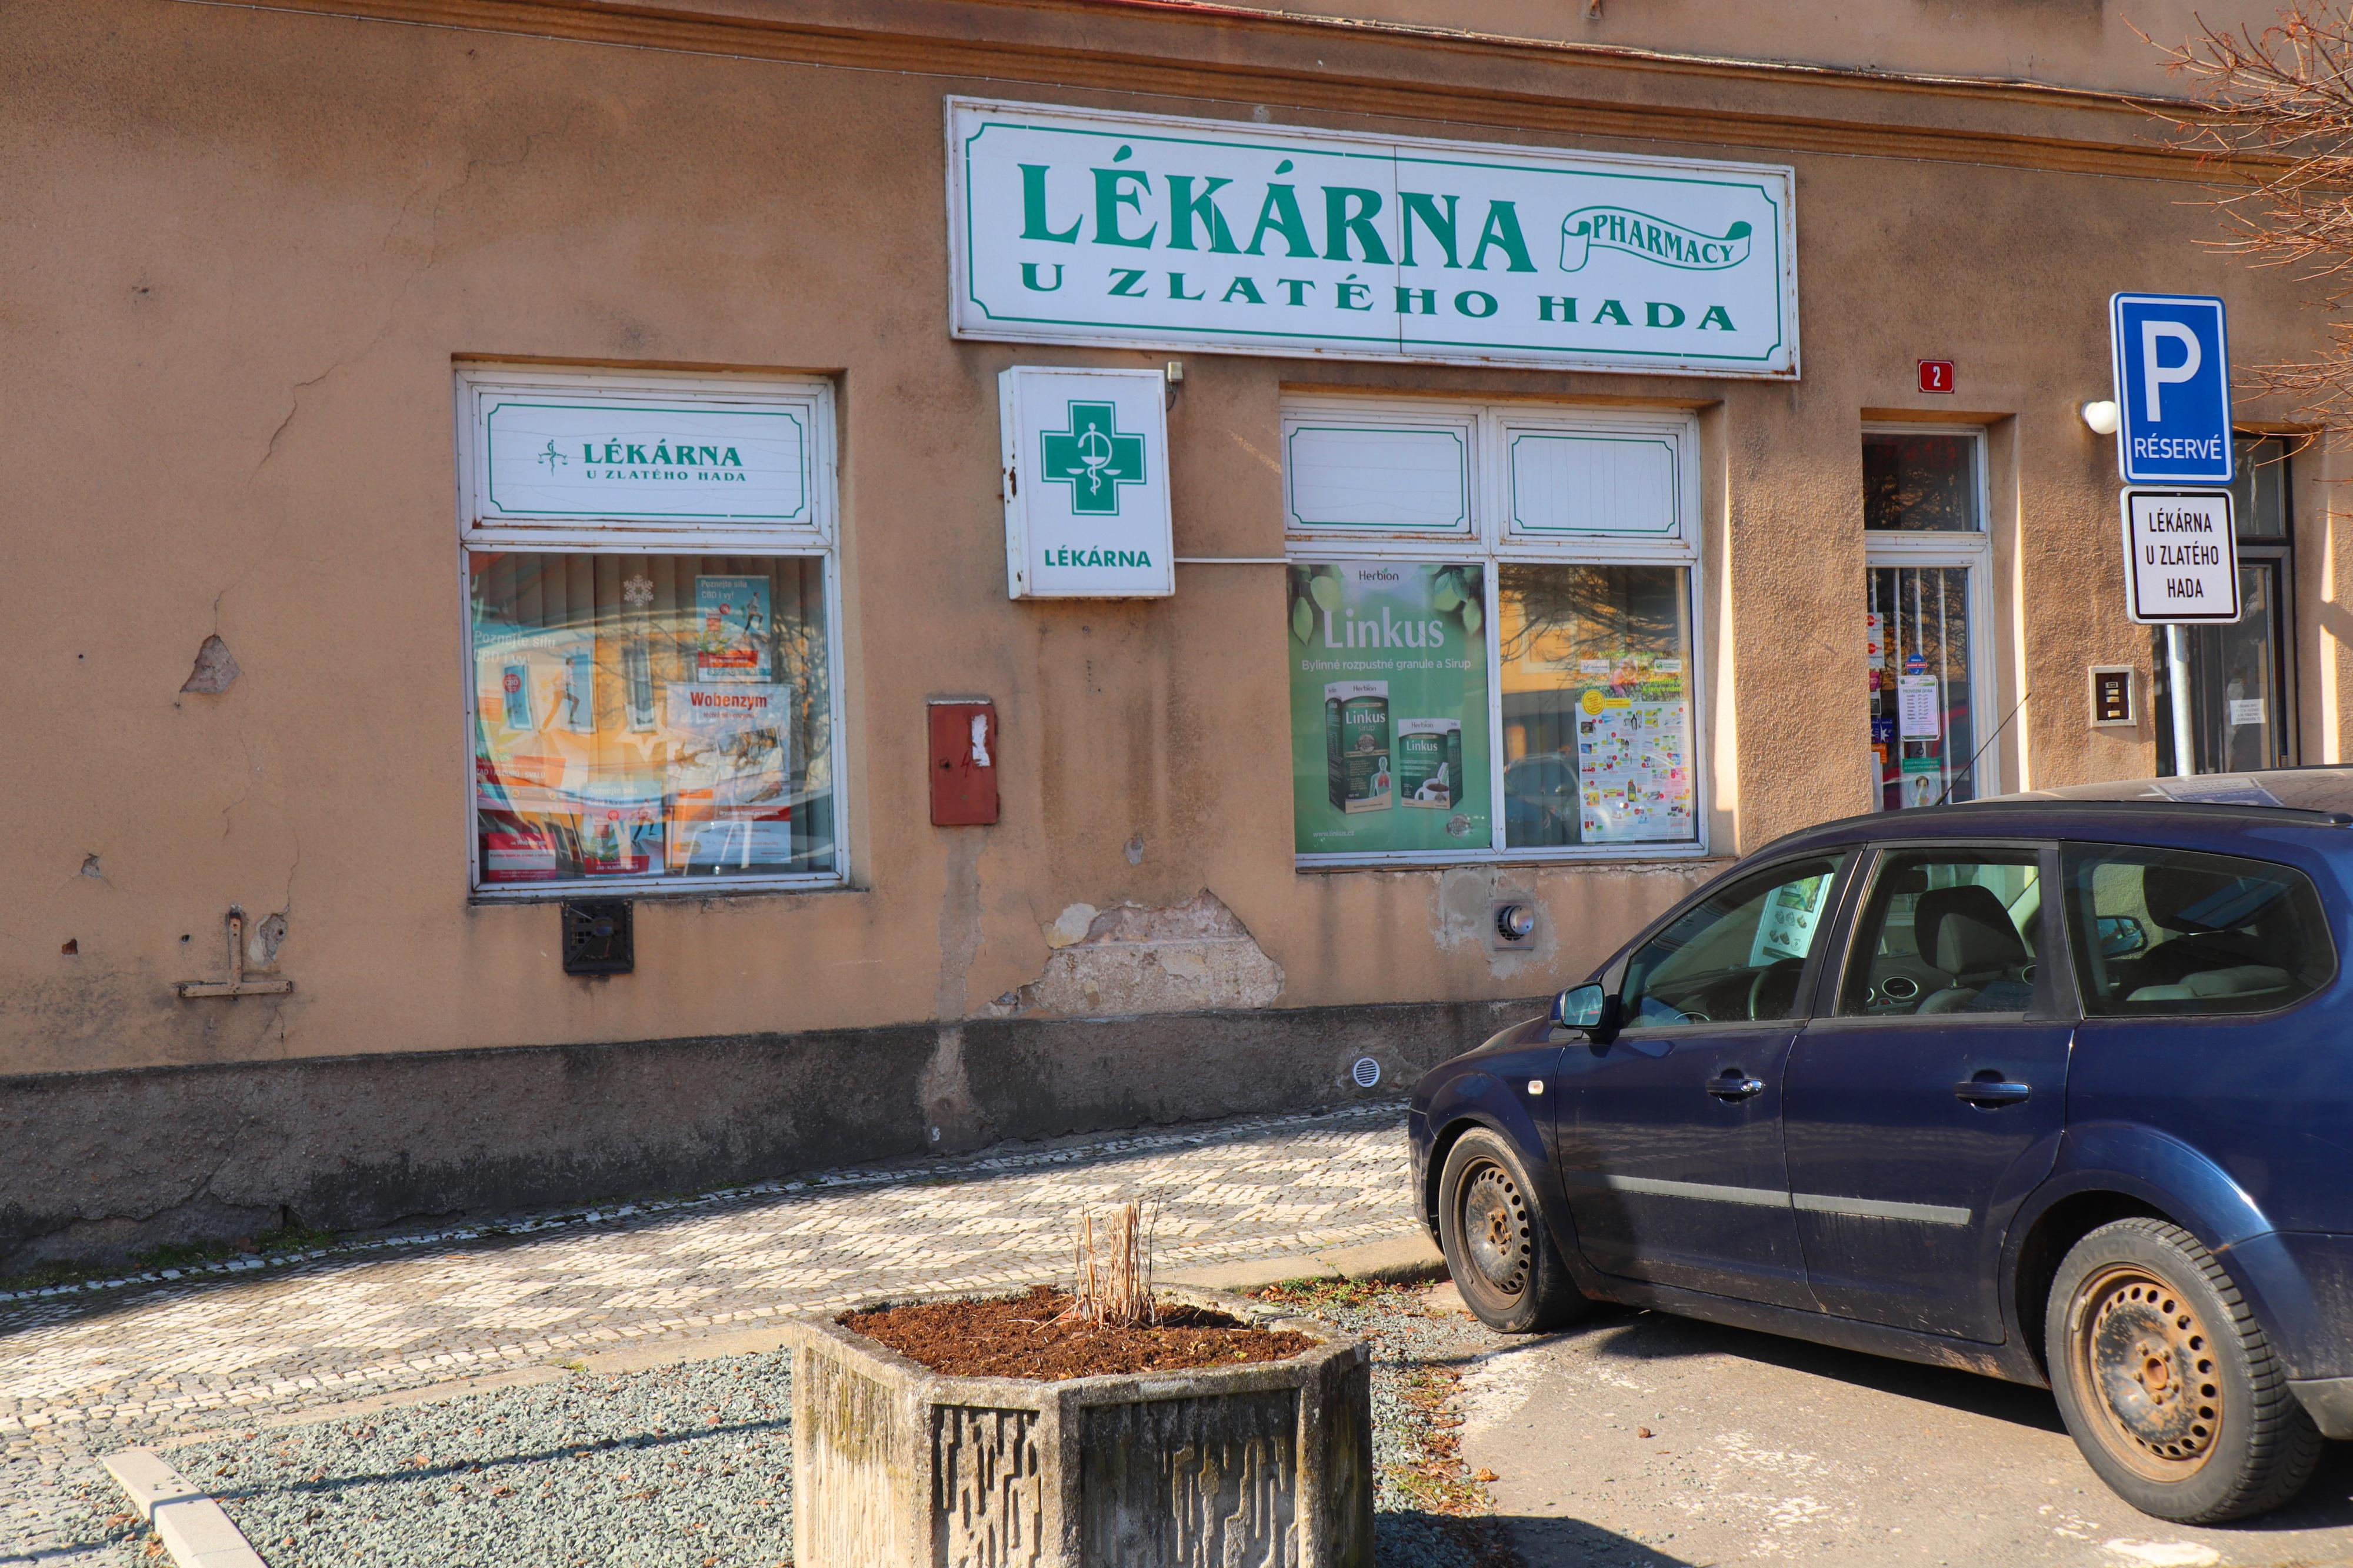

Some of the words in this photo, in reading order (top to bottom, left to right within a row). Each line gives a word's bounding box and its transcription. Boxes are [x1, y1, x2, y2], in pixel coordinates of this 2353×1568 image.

[1018, 145, 1538, 273] LÉKÁRNA
[1593, 215, 1735, 264] PHARMACY
[1019, 262, 1065, 292] U
[1108, 268, 1498, 318] ZLATÉHO
[1538, 295, 1738, 332] HADA
[1933, 366, 1941, 386] 2
[2141, 320, 2201, 422] P
[582, 437, 743, 466] LÉKÁRNA
[2134, 433, 2222, 460] RÉSERVÉ
[586, 470, 596, 479] U
[605, 469, 688, 481] ZLATÉHO
[698, 472, 746, 482] HADA
[2148, 508, 2212, 533] LÉKÁRNA
[1044, 545, 1152, 567] LÉKÁRNA
[2146, 545, 2154, 565] U
[2159, 541, 2219, 565] ZLATÉHO
[701, 580, 732, 589] Poznejte
[734, 580, 747, 588] silu
[1359, 568, 1399, 581] Herbion
[2167, 578, 2204, 598] HADA
[1324, 606, 1444, 648] Linkus
[473, 630, 529, 649] Poznejte
[532, 635, 555, 648] silu
[473, 649, 499, 663] CBD
[1302, 659, 1340, 672] Bylinné
[1342, 659, 1394, 671] rozpustné
[1396, 658, 1434, 671] granule
[1445, 658, 1471, 670] Sirup
[1345, 709, 1386, 724] Linkus
[1407, 740, 1438, 752] Linkus
